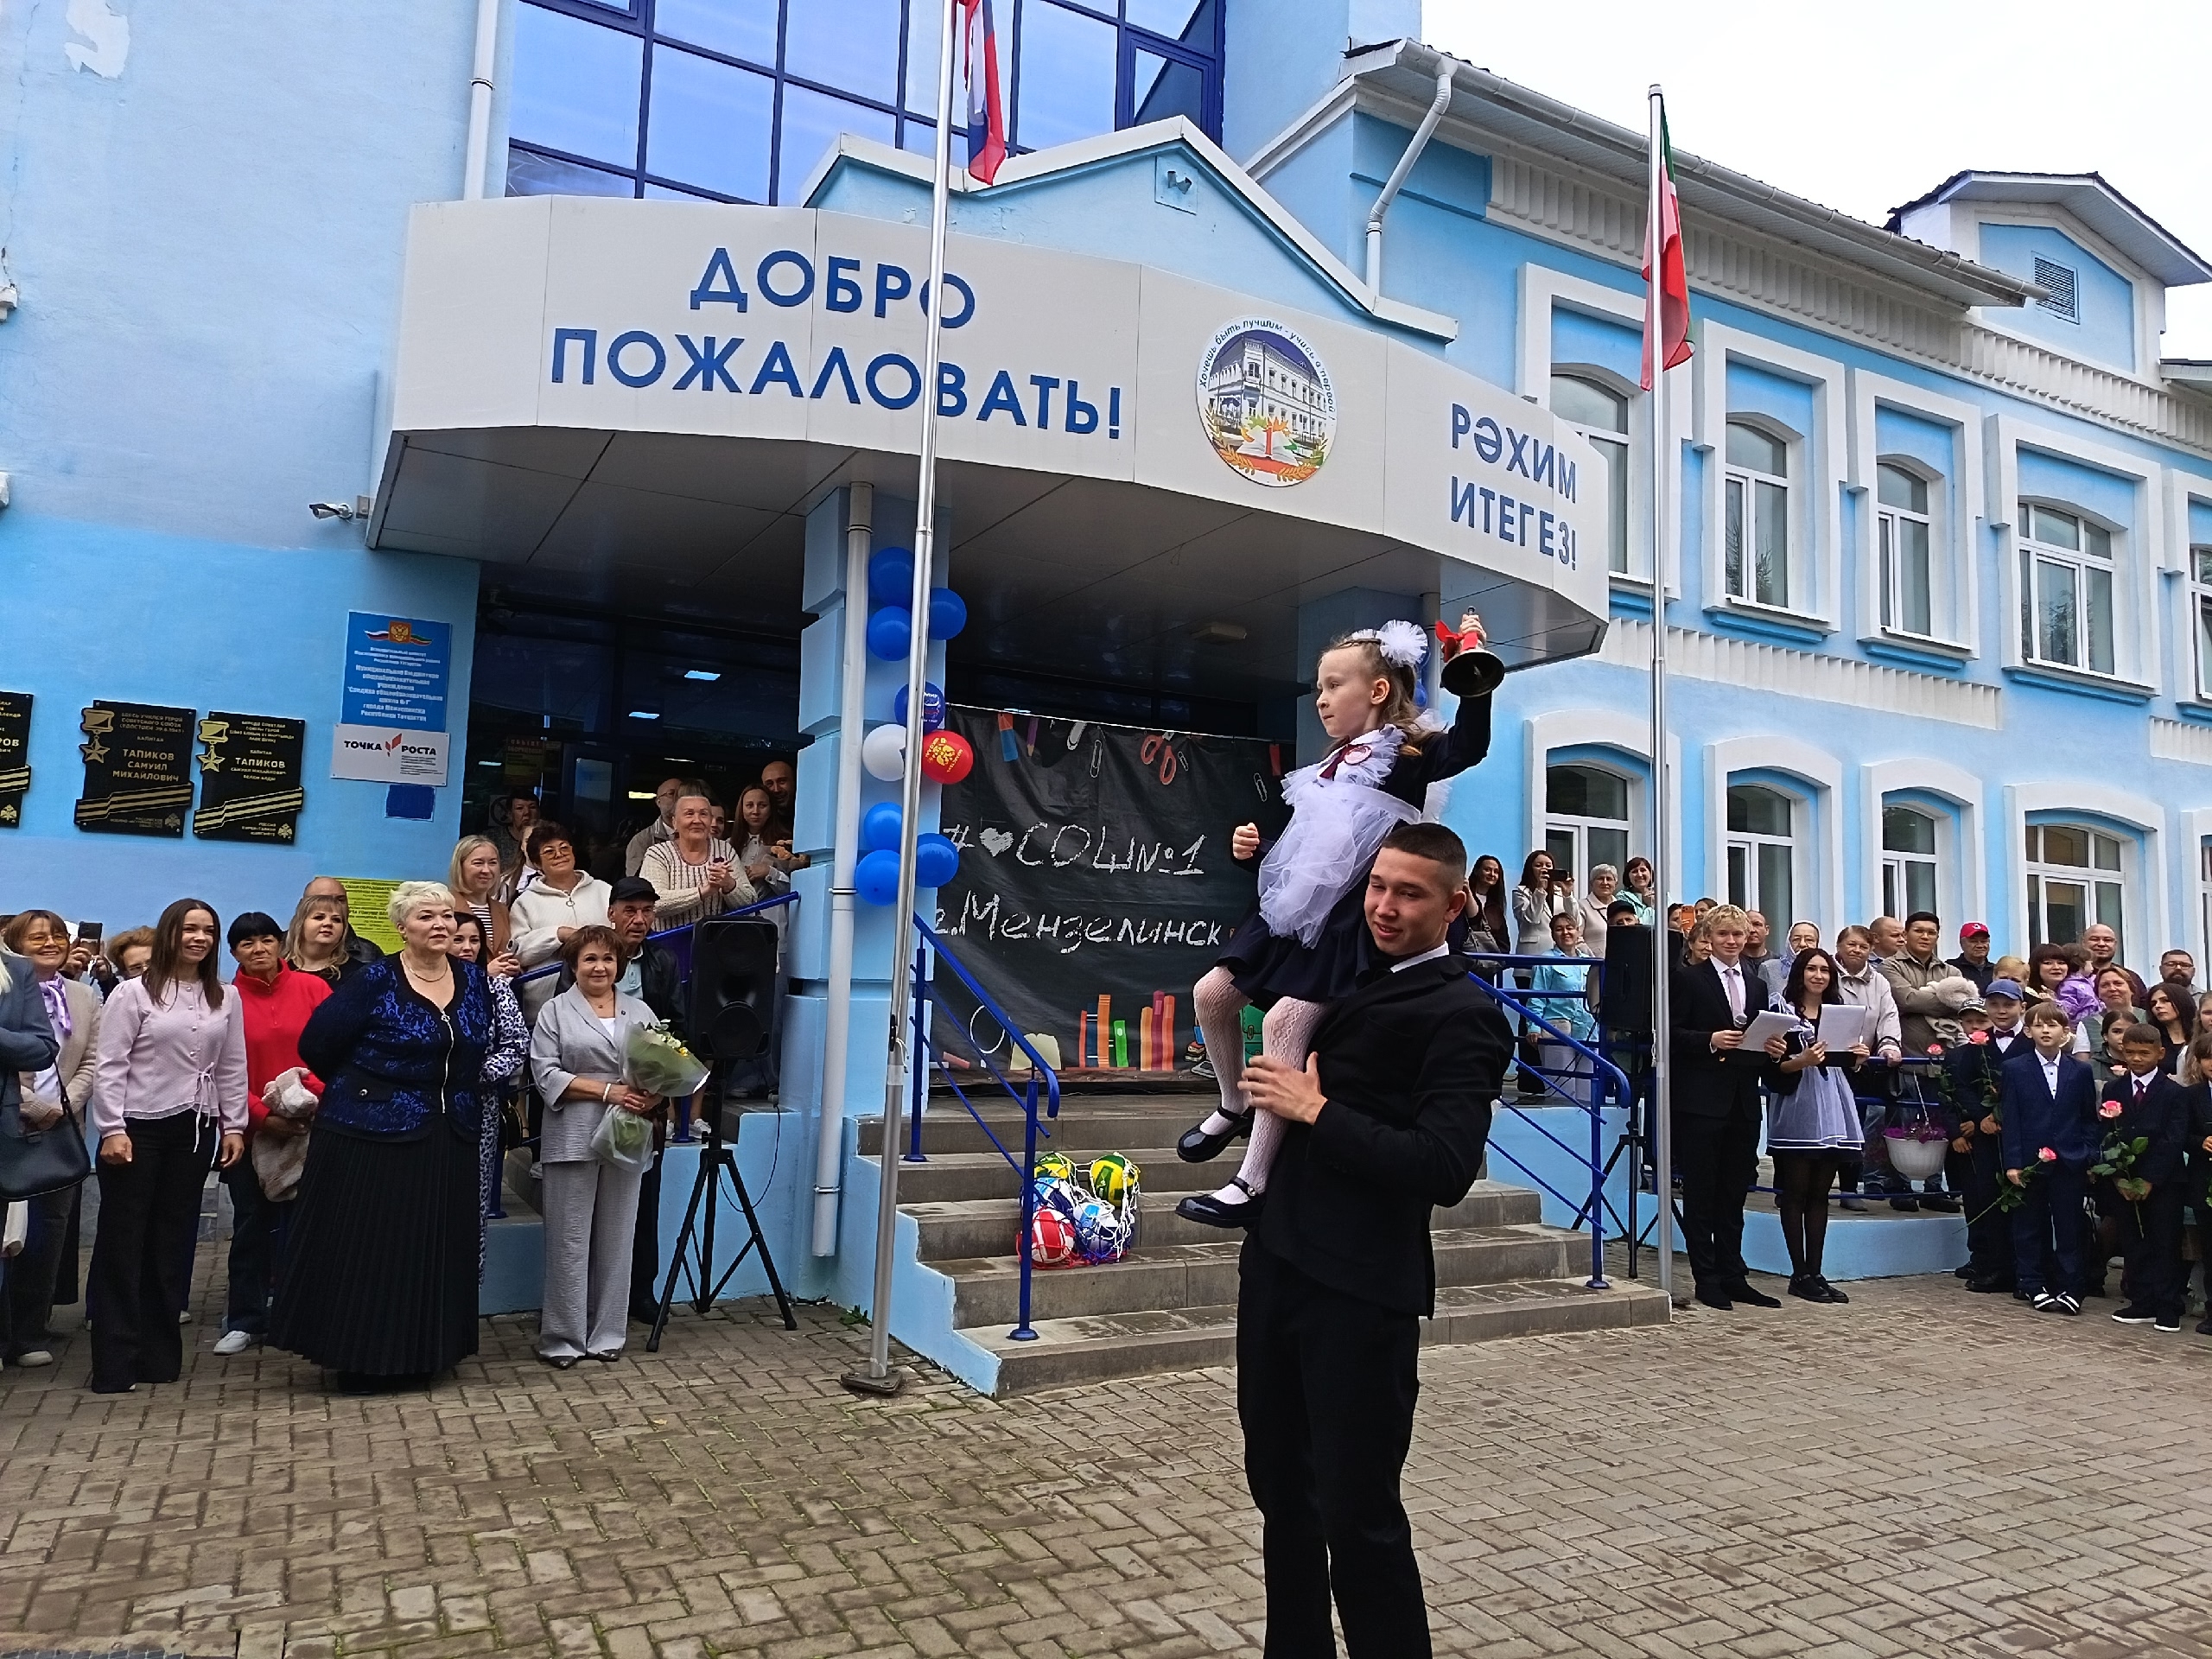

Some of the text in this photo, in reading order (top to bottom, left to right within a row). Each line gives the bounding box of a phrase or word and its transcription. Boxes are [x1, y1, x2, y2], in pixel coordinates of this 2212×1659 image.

[690, 247, 975, 329] ДОБРО
[1199, 346, 1217, 389] Хочешь
[1215, 324, 1241, 345] быть
[1243, 320, 1284, 332] лучшим
[550, 327, 1121, 439] ПОЖАЛОВАТЬ!
[1452, 403, 1576, 504] РӘХИМ
[1450, 475, 1576, 571] ИТЕГЕЗ!
[123, 749, 175, 760] ТАПИКОВ
[127, 761, 168, 771] САМУИЛ
[235, 757, 286, 768] ТАПИКОВ
[344, 740, 436, 755] ТОЧКА РОСТА
[112, 770, 180, 782] МИХАЙЛОВИЧ
